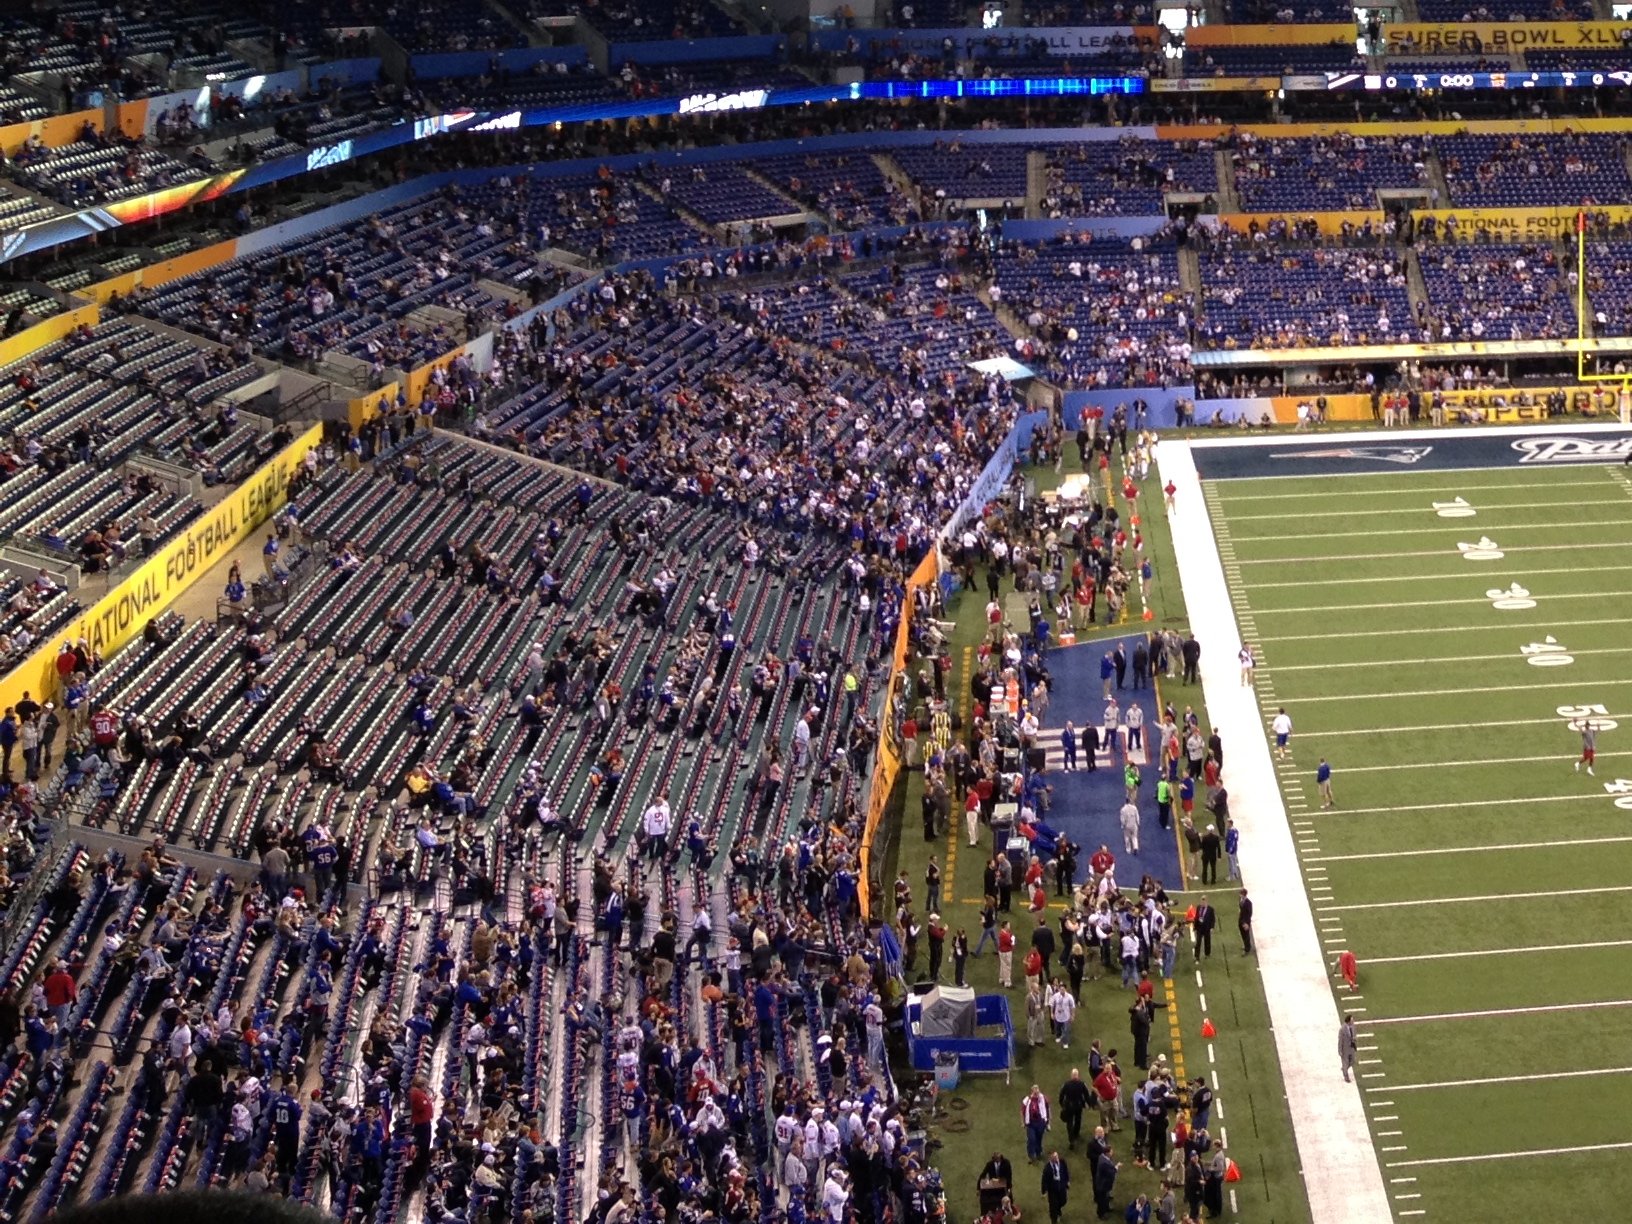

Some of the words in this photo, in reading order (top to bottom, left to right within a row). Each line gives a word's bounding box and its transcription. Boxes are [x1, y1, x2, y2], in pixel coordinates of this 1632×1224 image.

[1493, 30, 1565, 45] BOWL
[1440, 75, 1475, 87] 0:00
[1436, 218, 1518, 230] NTIONAL
[86, 572, 161, 654] NATIONAL
[165, 507, 238, 591] FOOTBALL
[240, 461, 290, 523] LEAGUE
[95, 722, 110, 735] 90
[317, 852, 331, 864] 56
[620, 1096, 635, 1110] 56
